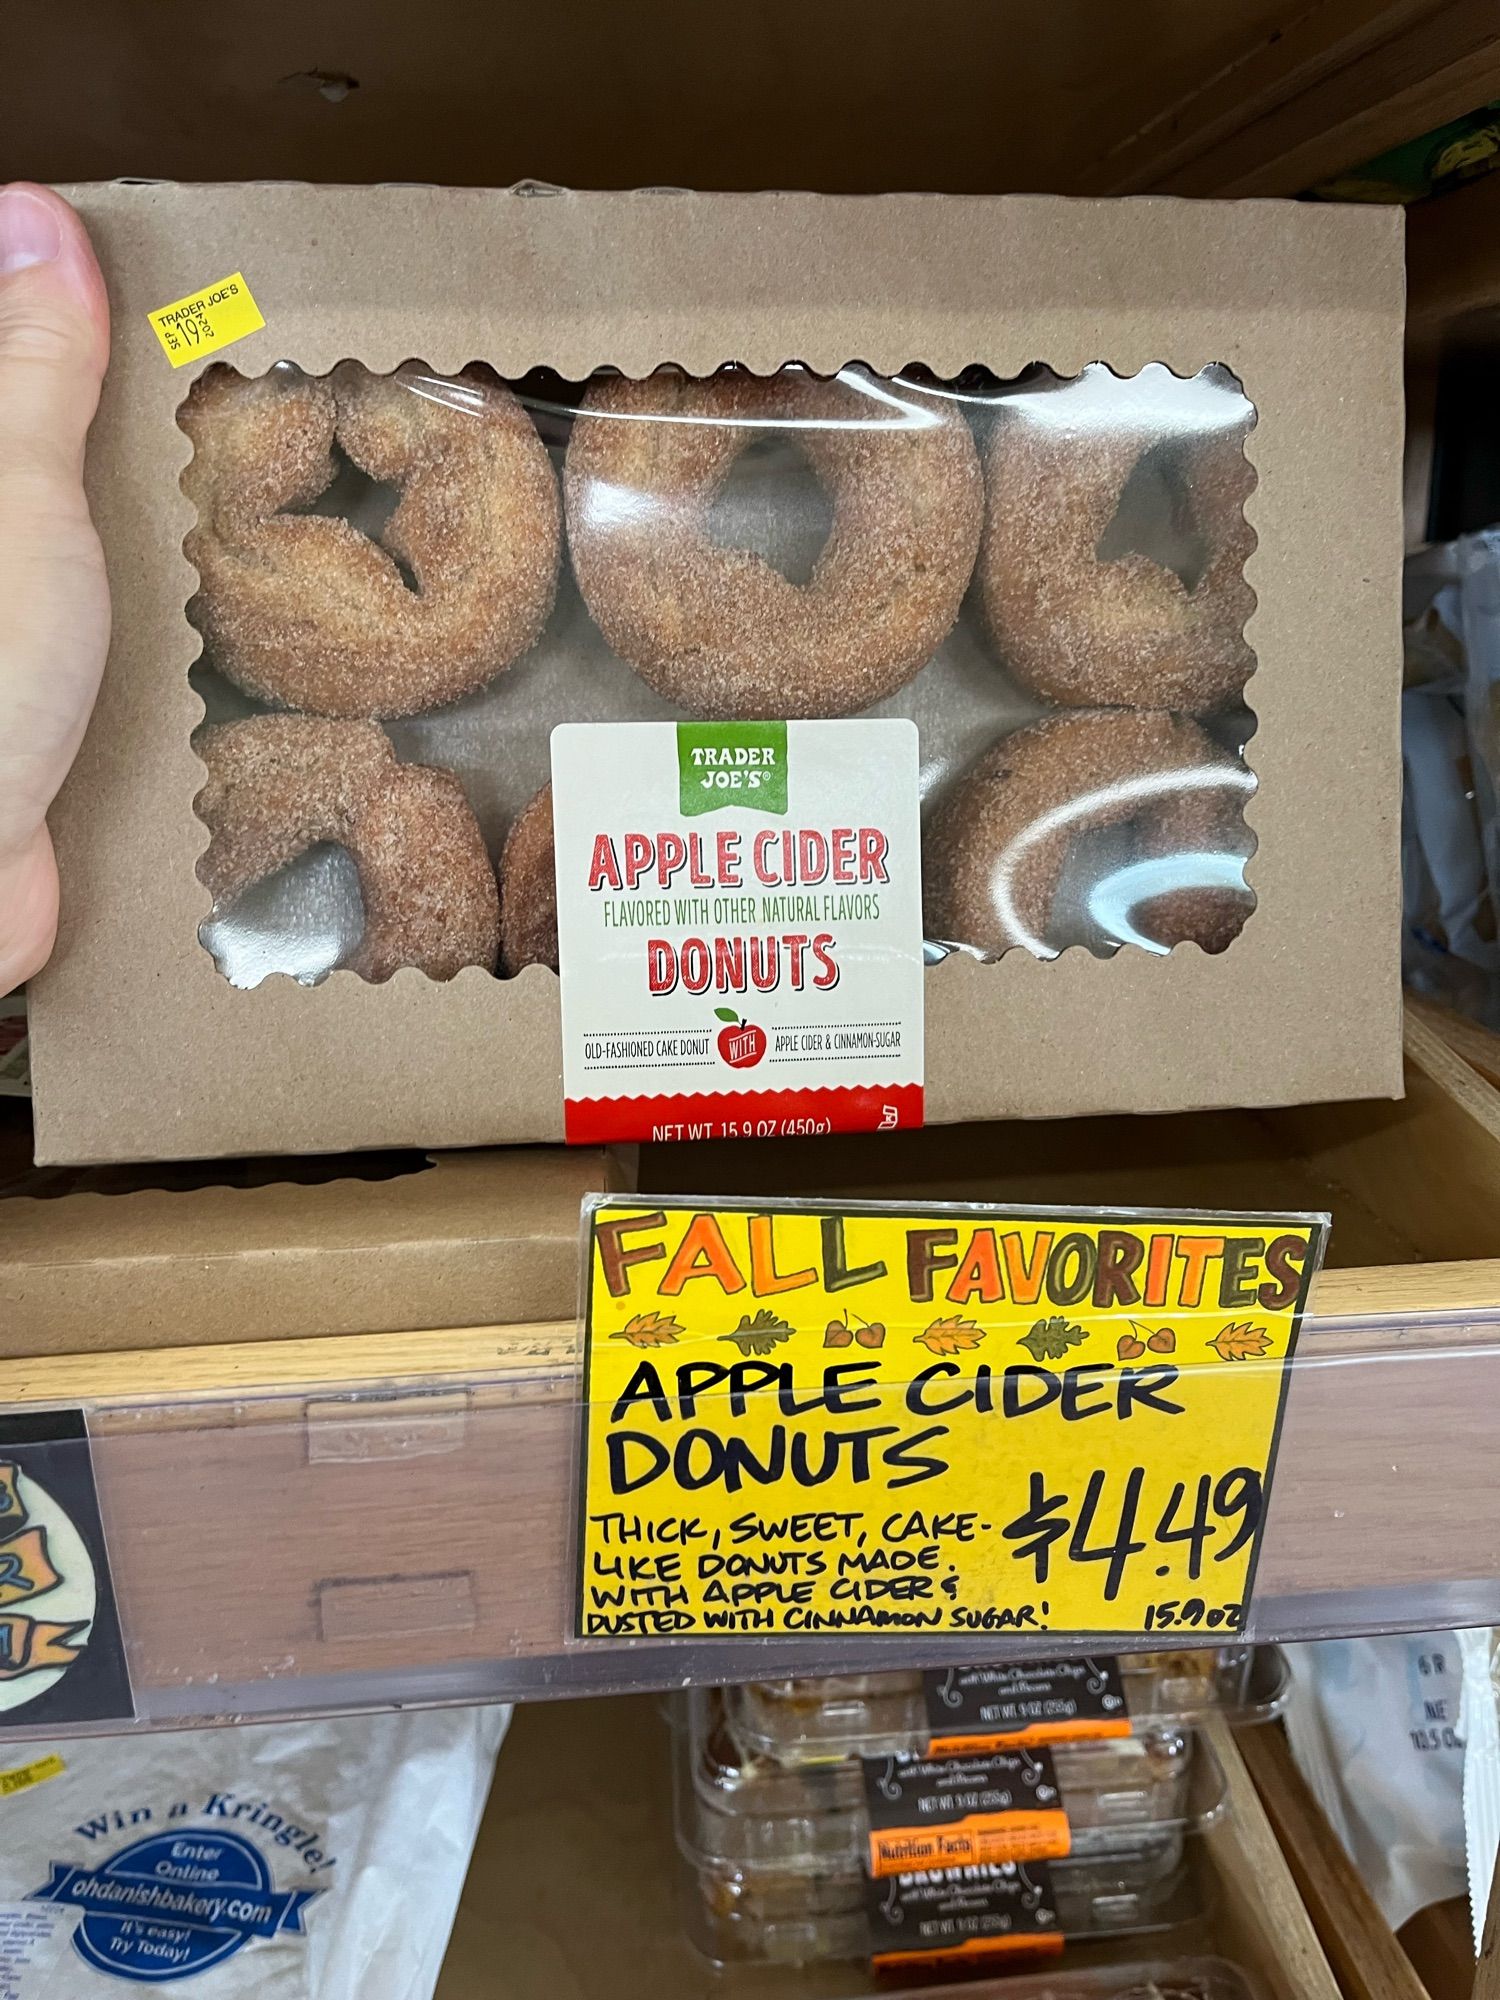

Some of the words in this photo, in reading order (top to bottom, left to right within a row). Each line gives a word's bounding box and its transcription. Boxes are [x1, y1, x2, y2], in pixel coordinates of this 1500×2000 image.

[158, 300, 206, 327] TRADER
[208, 284, 239, 307] JOE'S
[164, 332, 181, 350] SEP
[176, 319, 200, 347] 19
[690, 747, 776, 766] TRADER
[587, 831, 743, 891] APPLE
[752, 827, 891, 887] CIDER
[604, 899, 671, 928] FLAVORED
[674, 898, 709, 926] WITH
[714, 897, 756, 924] OTHER
[762, 895, 821, 923] NATURAL
[824, 893, 881, 921] FLAVORS
[647, 933, 841, 996] DONUTS
[585, 1040, 656, 1060] OLD-FASHIONED
[656, 1039, 679, 1057] CAKE
[680, 1038, 709, 1056] DONUT
[728, 1034, 756, 1060] WITH
[775, 1034, 799, 1051] APPLE
[801, 1033, 822, 1050] CIDER
[825, 1034, 831, 1049] &
[834, 1030, 901, 1049] CINNAMON-SUGAR
[652, 1124, 685, 1142] NET
[688, 1122, 713, 1140] WT
[757, 1119, 776, 1137] OZ
[595, 1211, 888, 1298] FALL
[906, 1228, 1310, 1310] FAVORITES
[611, 1360, 882, 1423] APPLE
[905, 1361, 1186, 1421] CIDER
[606, 1425, 950, 1495] DONUTS
[589, 1511, 721, 1550] THICK,
[729, 1511, 868, 1548] SWEET,
[882, 1512, 992, 1542] CAKE-
[1002, 1466, 1263, 1600] $4.49
[593, 1552, 682, 1582] LIKE
[699, 1550, 827, 1579] DONUTS
[591, 1581, 690, 1608] WITH
[702, 1578, 817, 1605] APPLE
[829, 1575, 935, 1603] CIDER
[587, 1609, 697, 1635] DUSTED
[704, 1608, 775, 1630] WITH
[783, 1605, 942, 1630] CINNAMON
[949, 1601, 1050, 1631] SUGAR!
[74, 1806, 152, 1843] Win
[201, 1792, 337, 1875] Kringle!
[171, 1841, 222, 1862] Enter
[154, 1860, 220, 1882] Online
[71, 1877, 273, 1926] ohdanishbakery.com
[110, 1936, 135, 1955] Try
[136, 1938, 191, 1963] Today!
